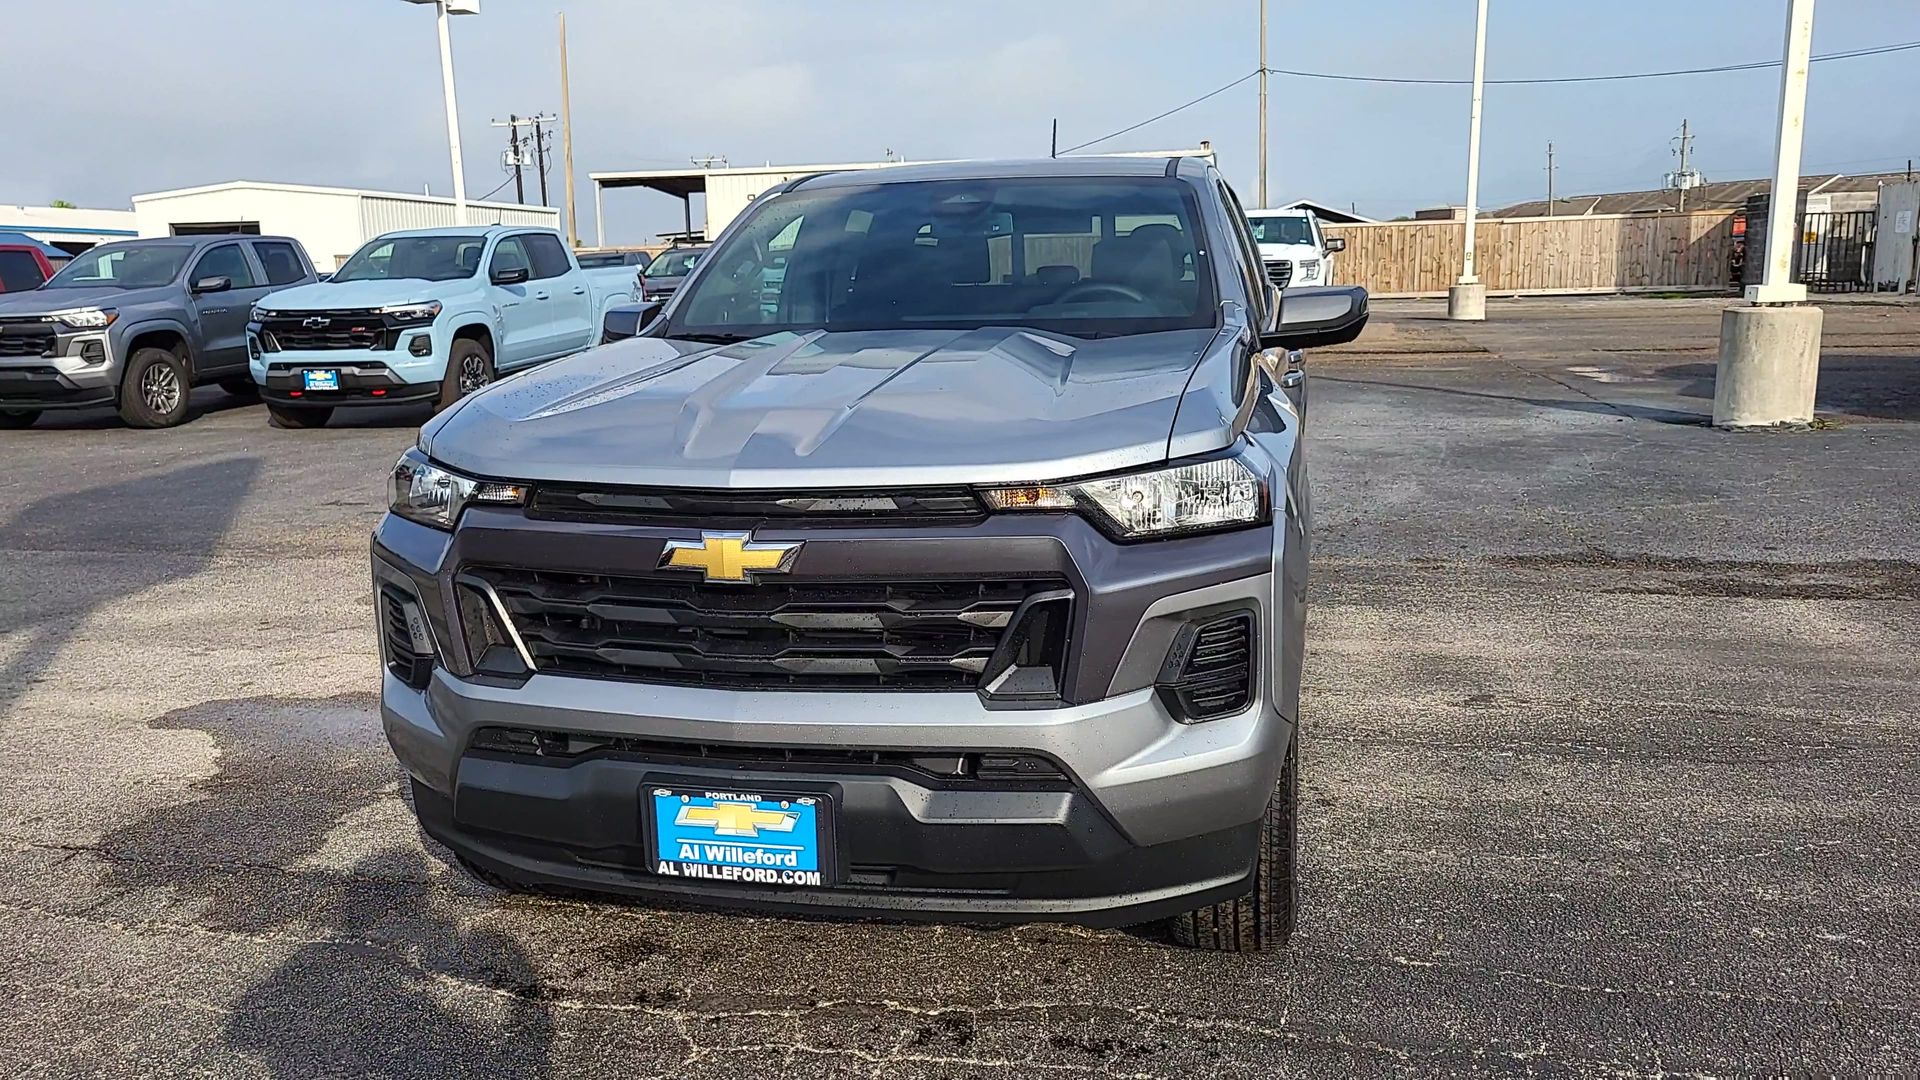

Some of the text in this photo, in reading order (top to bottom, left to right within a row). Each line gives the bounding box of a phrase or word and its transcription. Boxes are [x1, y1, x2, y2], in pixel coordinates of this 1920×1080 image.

[705, 791, 762, 802] PORTLAND
[679, 844, 797, 867] Al Willeford
[658, 861, 821, 886] AL WILLEFORD.COM
